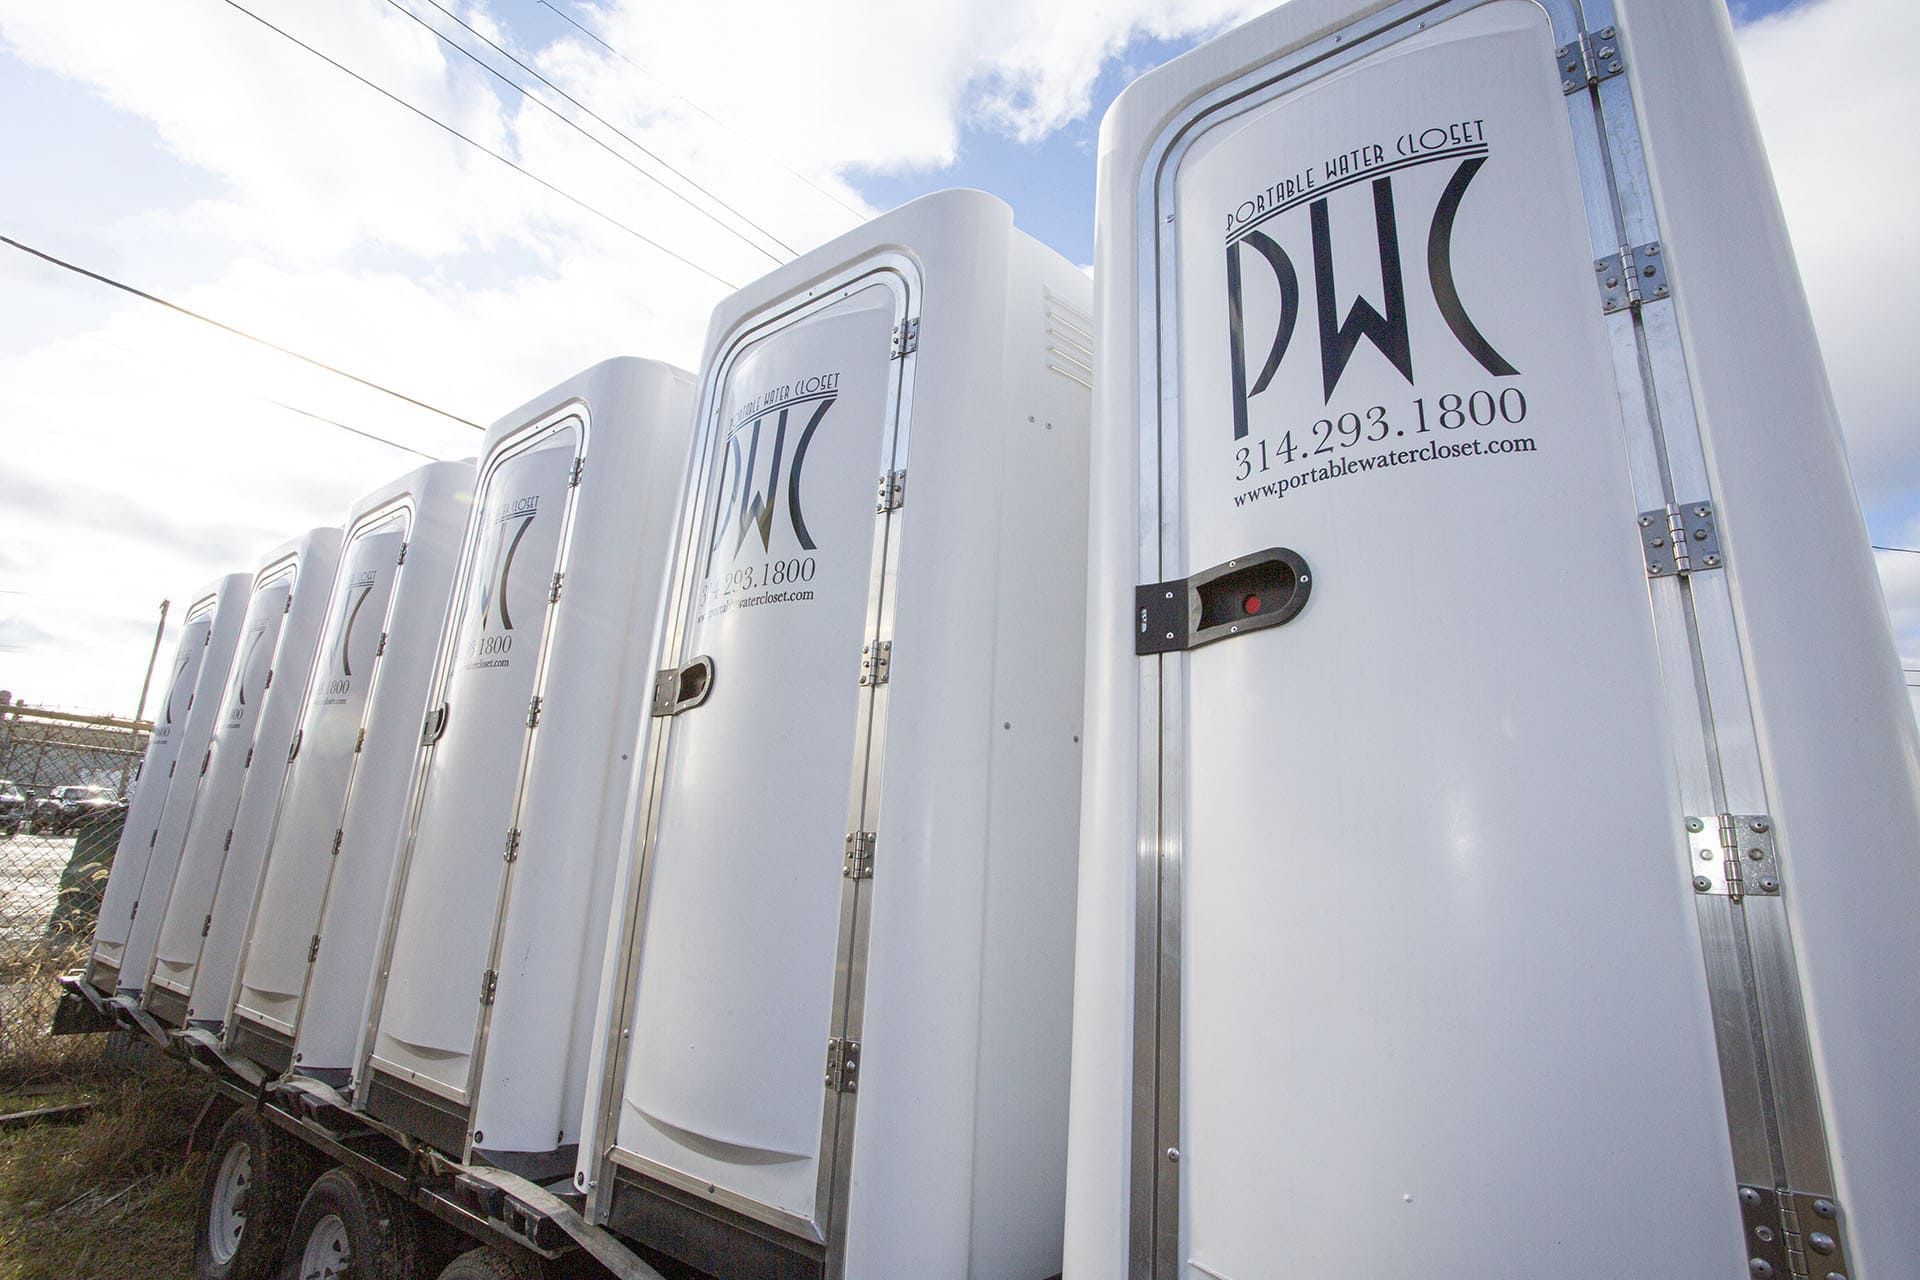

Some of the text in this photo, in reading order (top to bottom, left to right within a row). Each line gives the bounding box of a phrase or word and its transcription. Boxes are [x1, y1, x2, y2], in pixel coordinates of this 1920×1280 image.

[1226, 119, 1484, 231] PORTABLE WATER CLOSET
[1226, 156, 1521, 441] PWC
[764, 385, 790, 406] WATER
[795, 373, 840, 395] CLOSET
[1235, 387, 1528, 482] 314.293.1800
[705, 398, 838, 579] PWC
[1234, 434, 1537, 508] www.portablewatercloset.com
